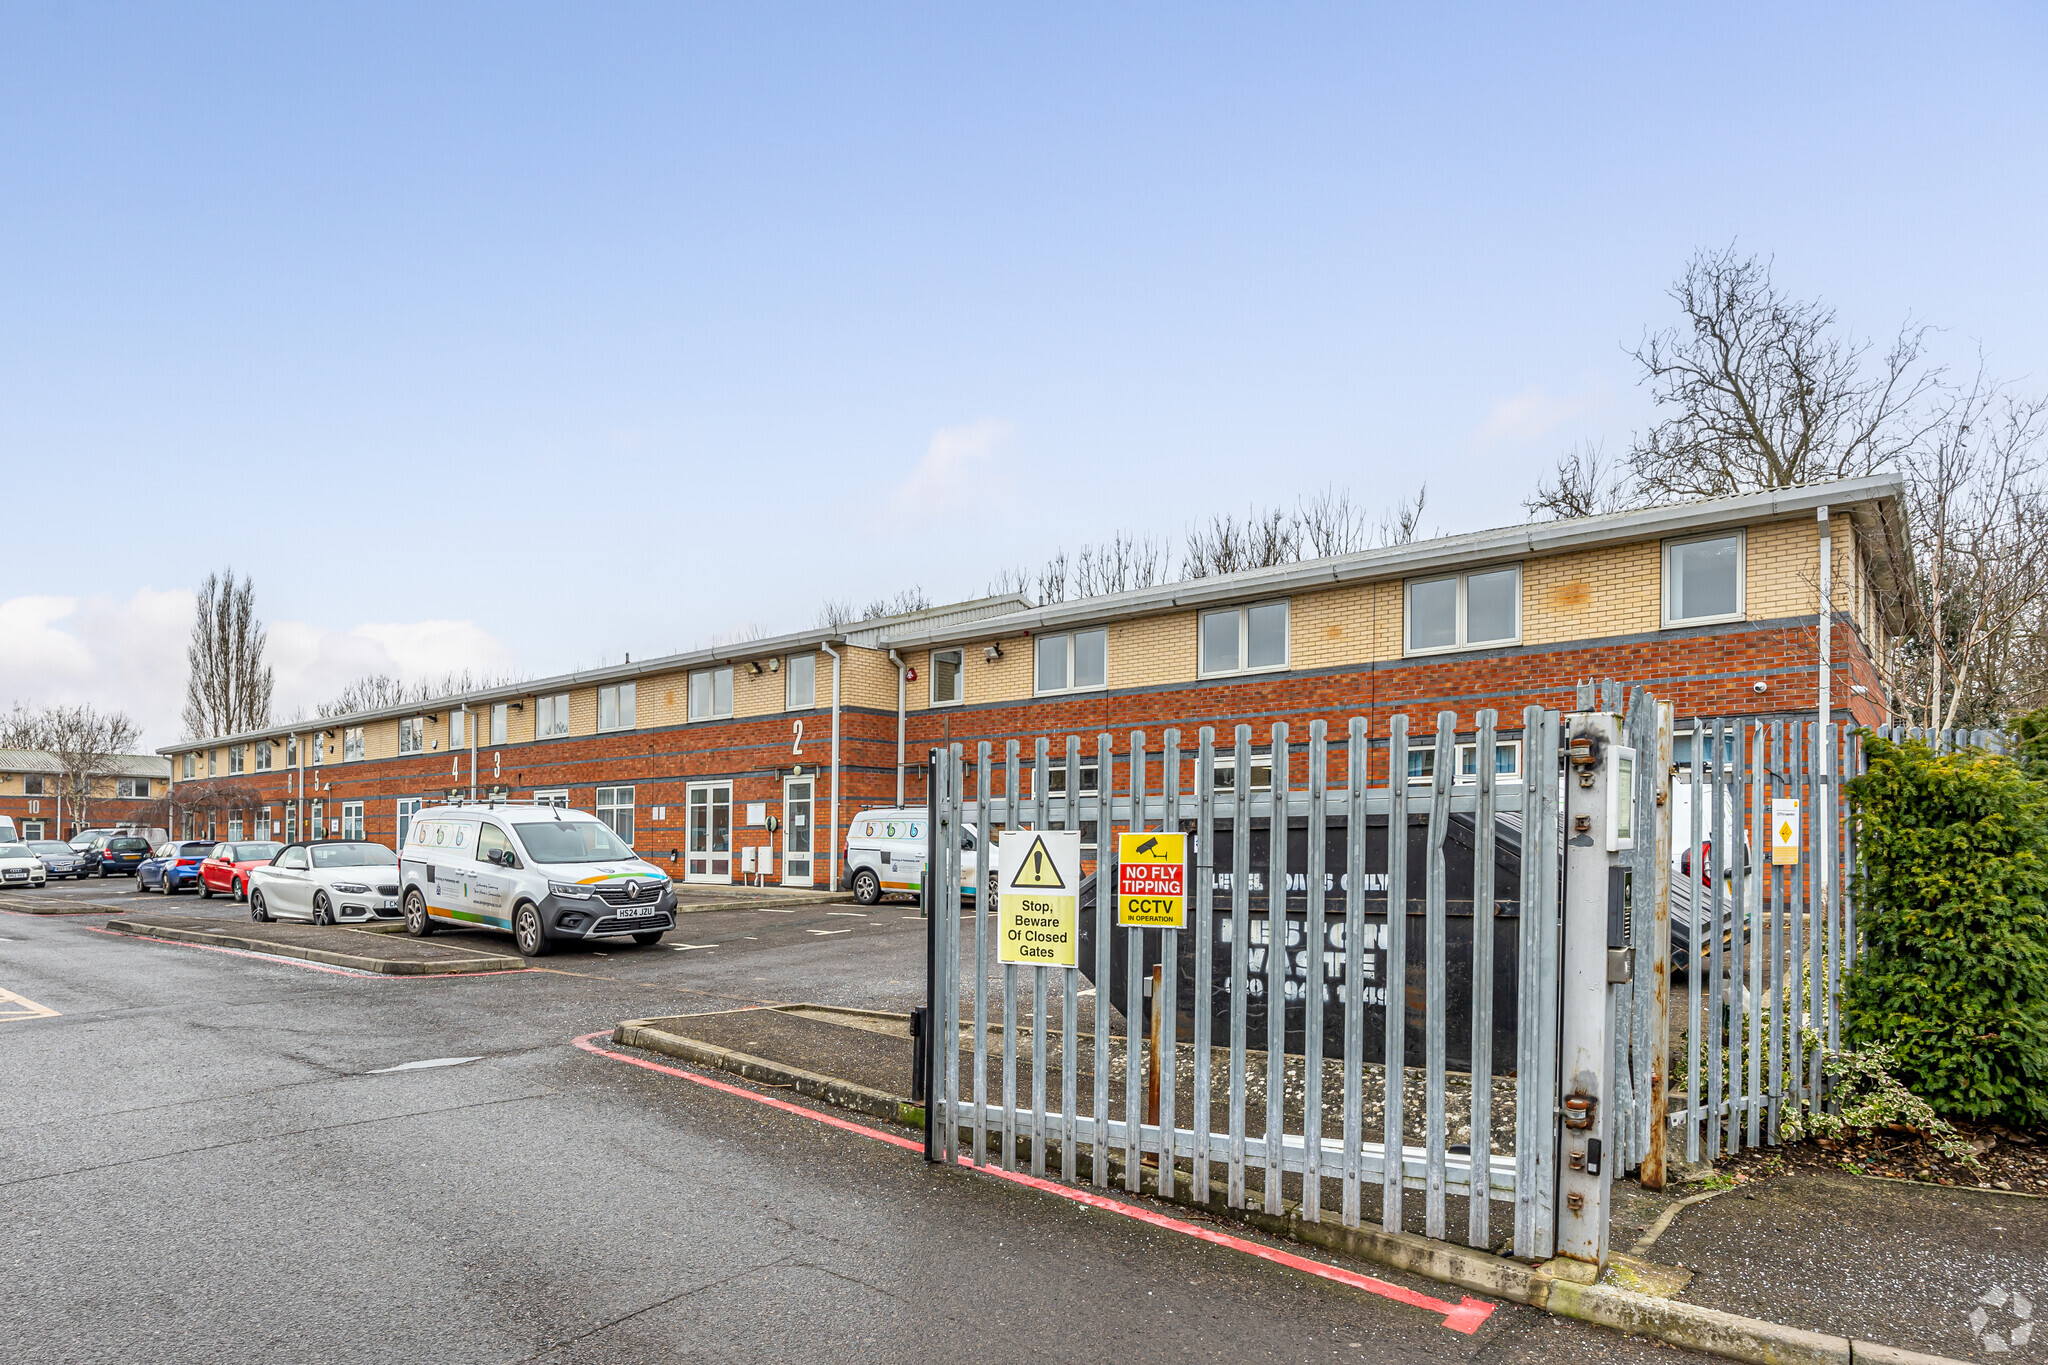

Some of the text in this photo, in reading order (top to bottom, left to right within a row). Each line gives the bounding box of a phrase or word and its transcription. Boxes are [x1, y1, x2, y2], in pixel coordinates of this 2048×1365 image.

[793, 719, 804, 756] 2
[452, 756, 458, 781] 4
[494, 751, 500, 778] 3
[314, 770, 319, 791] 5
[27, 799, 40, 814] 10
[1126, 866, 1178, 879] NO FLY
[1122, 880, 1181, 894] TIPPING
[619, 907, 653, 918] HS24 JZU
[1022, 900, 1053, 915] Stop,
[1128, 899, 1174, 914] CCTV
[1015, 915, 1060, 928] Beware
[1136, 915, 1174, 923] OPERATION
[1008, 929, 1068, 943] Of Closed
[1019, 945, 1055, 958] Gates
